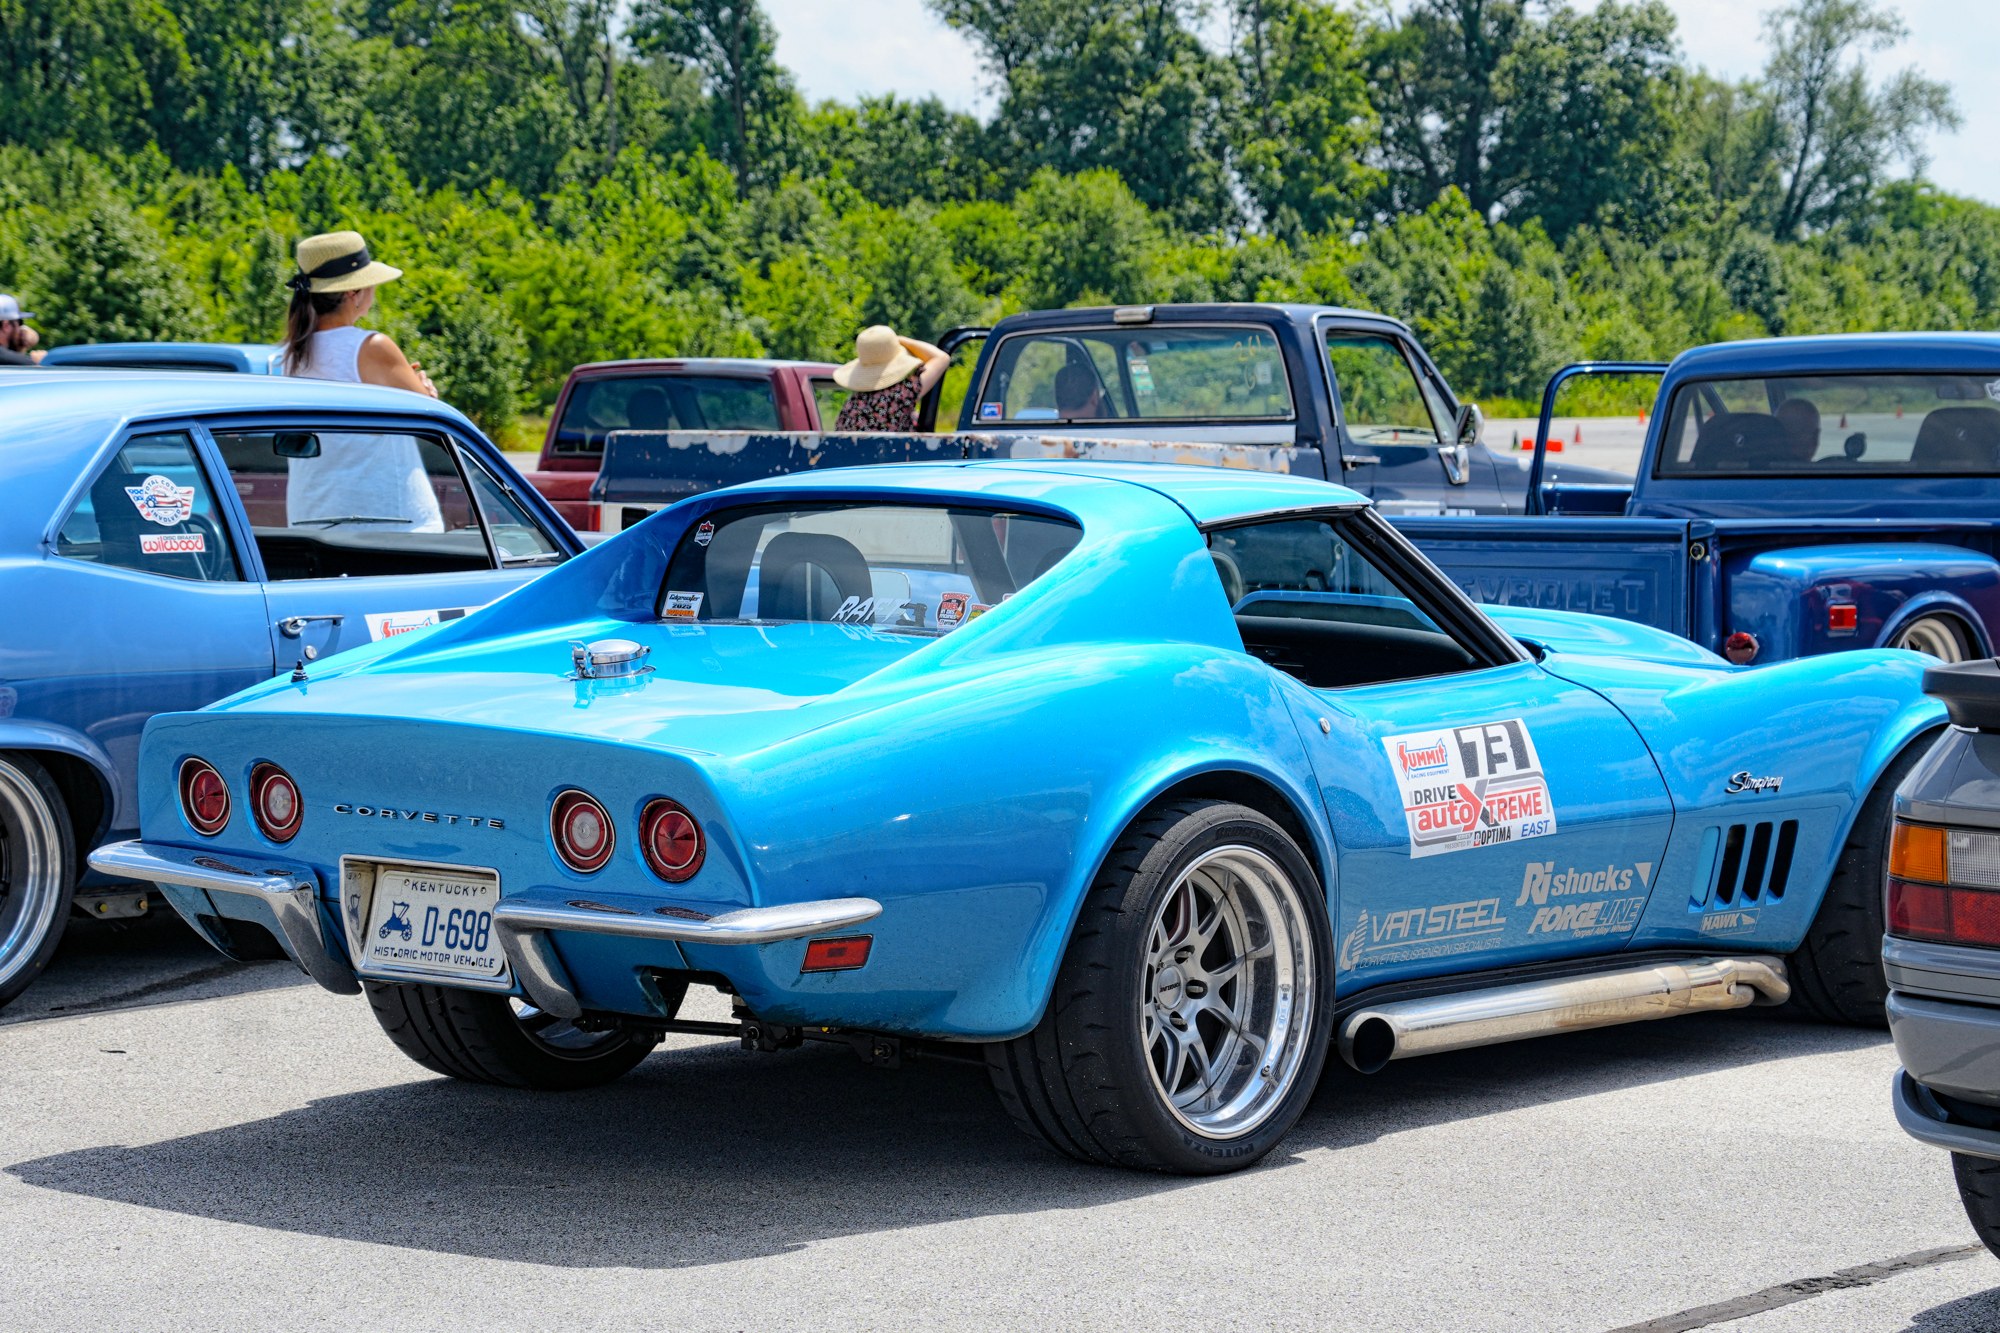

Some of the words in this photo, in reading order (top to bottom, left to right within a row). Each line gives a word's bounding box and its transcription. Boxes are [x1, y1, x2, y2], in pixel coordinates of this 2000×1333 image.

[145, 480, 159, 495] TOTAL
[161, 480, 178, 494] COST
[151, 509, 181, 522] INVOLVED
[143, 535, 204, 552] wilwood
[1459, 723, 1518, 777] 73
[1726, 771, 1783, 792] Stingray
[1414, 785, 1457, 805] DRIVE
[333, 804, 505, 829] CORVETTE
[1521, 820, 1550, 837] EAST
[1444, 841, 1466, 850] PRESENTED
[411, 881, 479, 897] KENTUCKY
[1551, 864, 1634, 896] shocks
[1527, 897, 1645, 935] FORGELINE
[1702, 912, 1741, 931] HAWK
[421, 906, 492, 952] D-698
[374, 945, 417, 960] HISTORIC
[420, 951, 451, 963] MOTOR
[453, 956, 495, 969] VEHICLE
[1360, 951, 1401, 968] CORVETTE
[1400, 944, 1453, 961] SUSPENSION
[1453, 938, 1502, 955] SPECIALISTS
[1183, 1133, 1255, 1158] POTENZA
